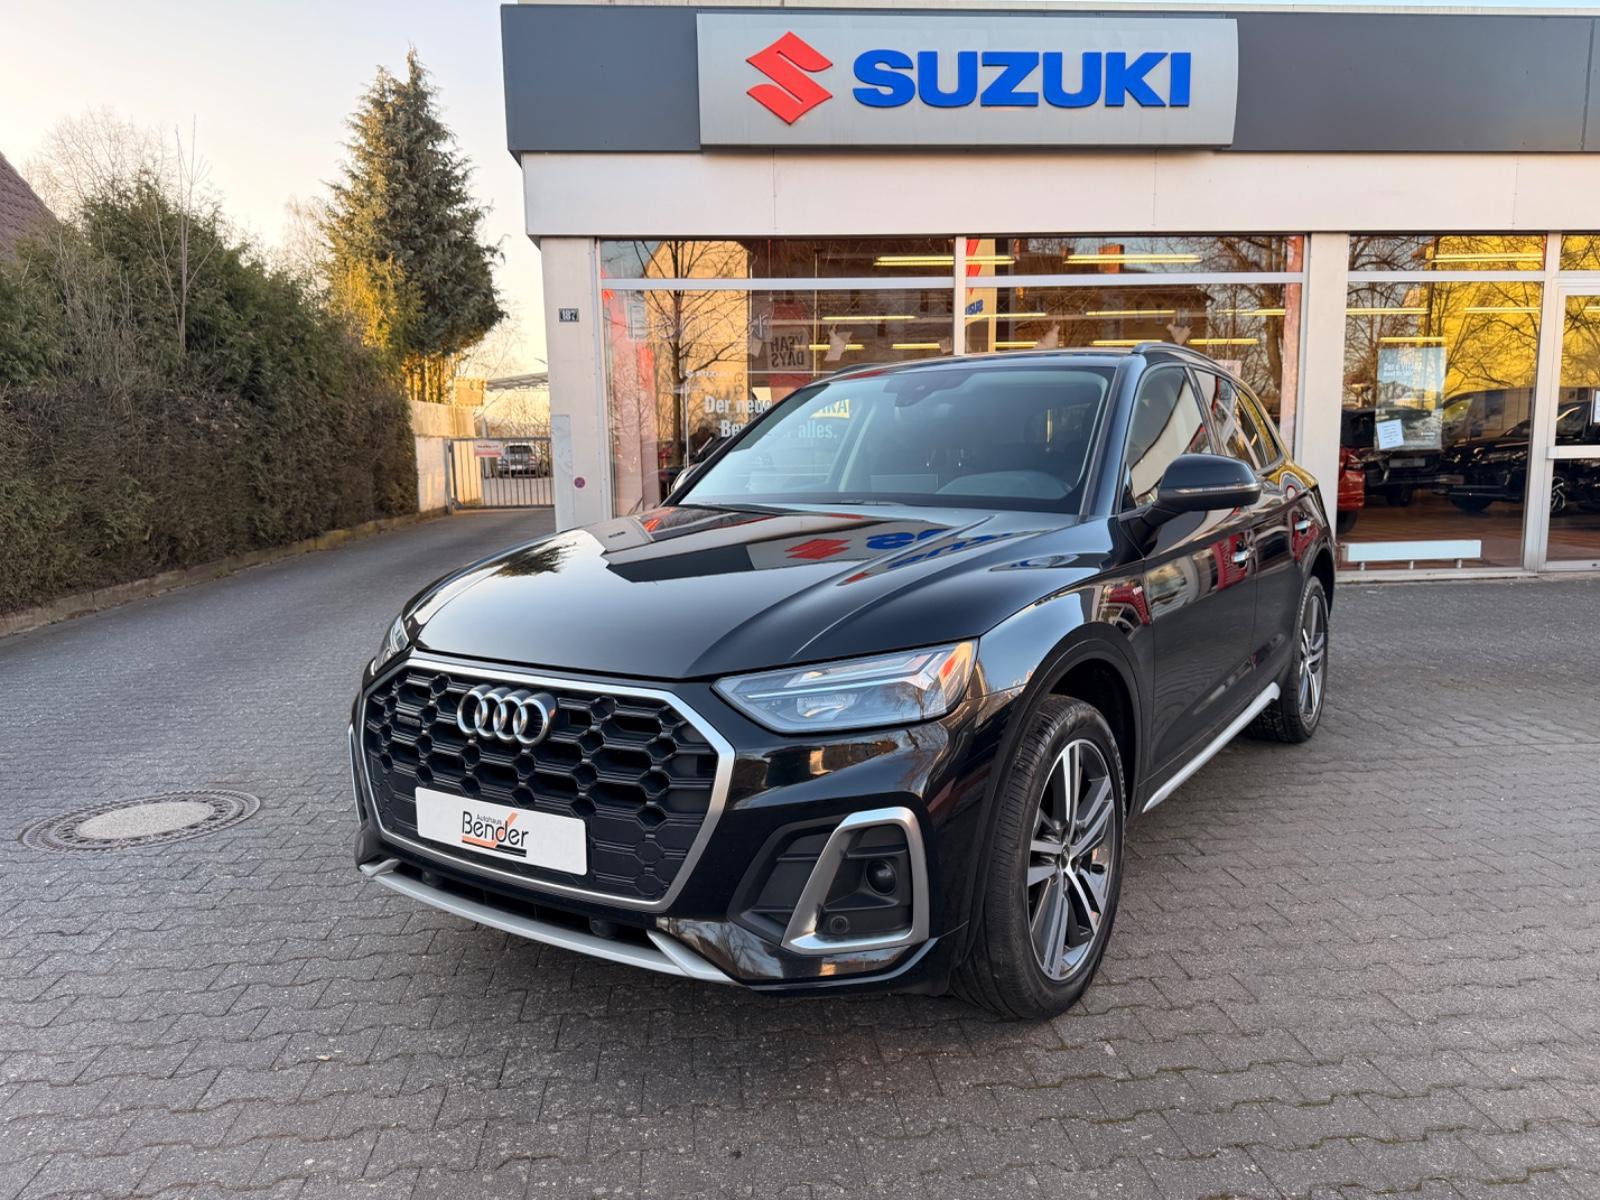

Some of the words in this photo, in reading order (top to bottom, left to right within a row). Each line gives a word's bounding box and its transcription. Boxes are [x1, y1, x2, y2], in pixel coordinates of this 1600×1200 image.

[852, 49, 1192, 108] SUZUKI
[562, 309, 577, 321] 187
[704, 396, 729, 414] Der
[463, 811, 529, 847] Bender
